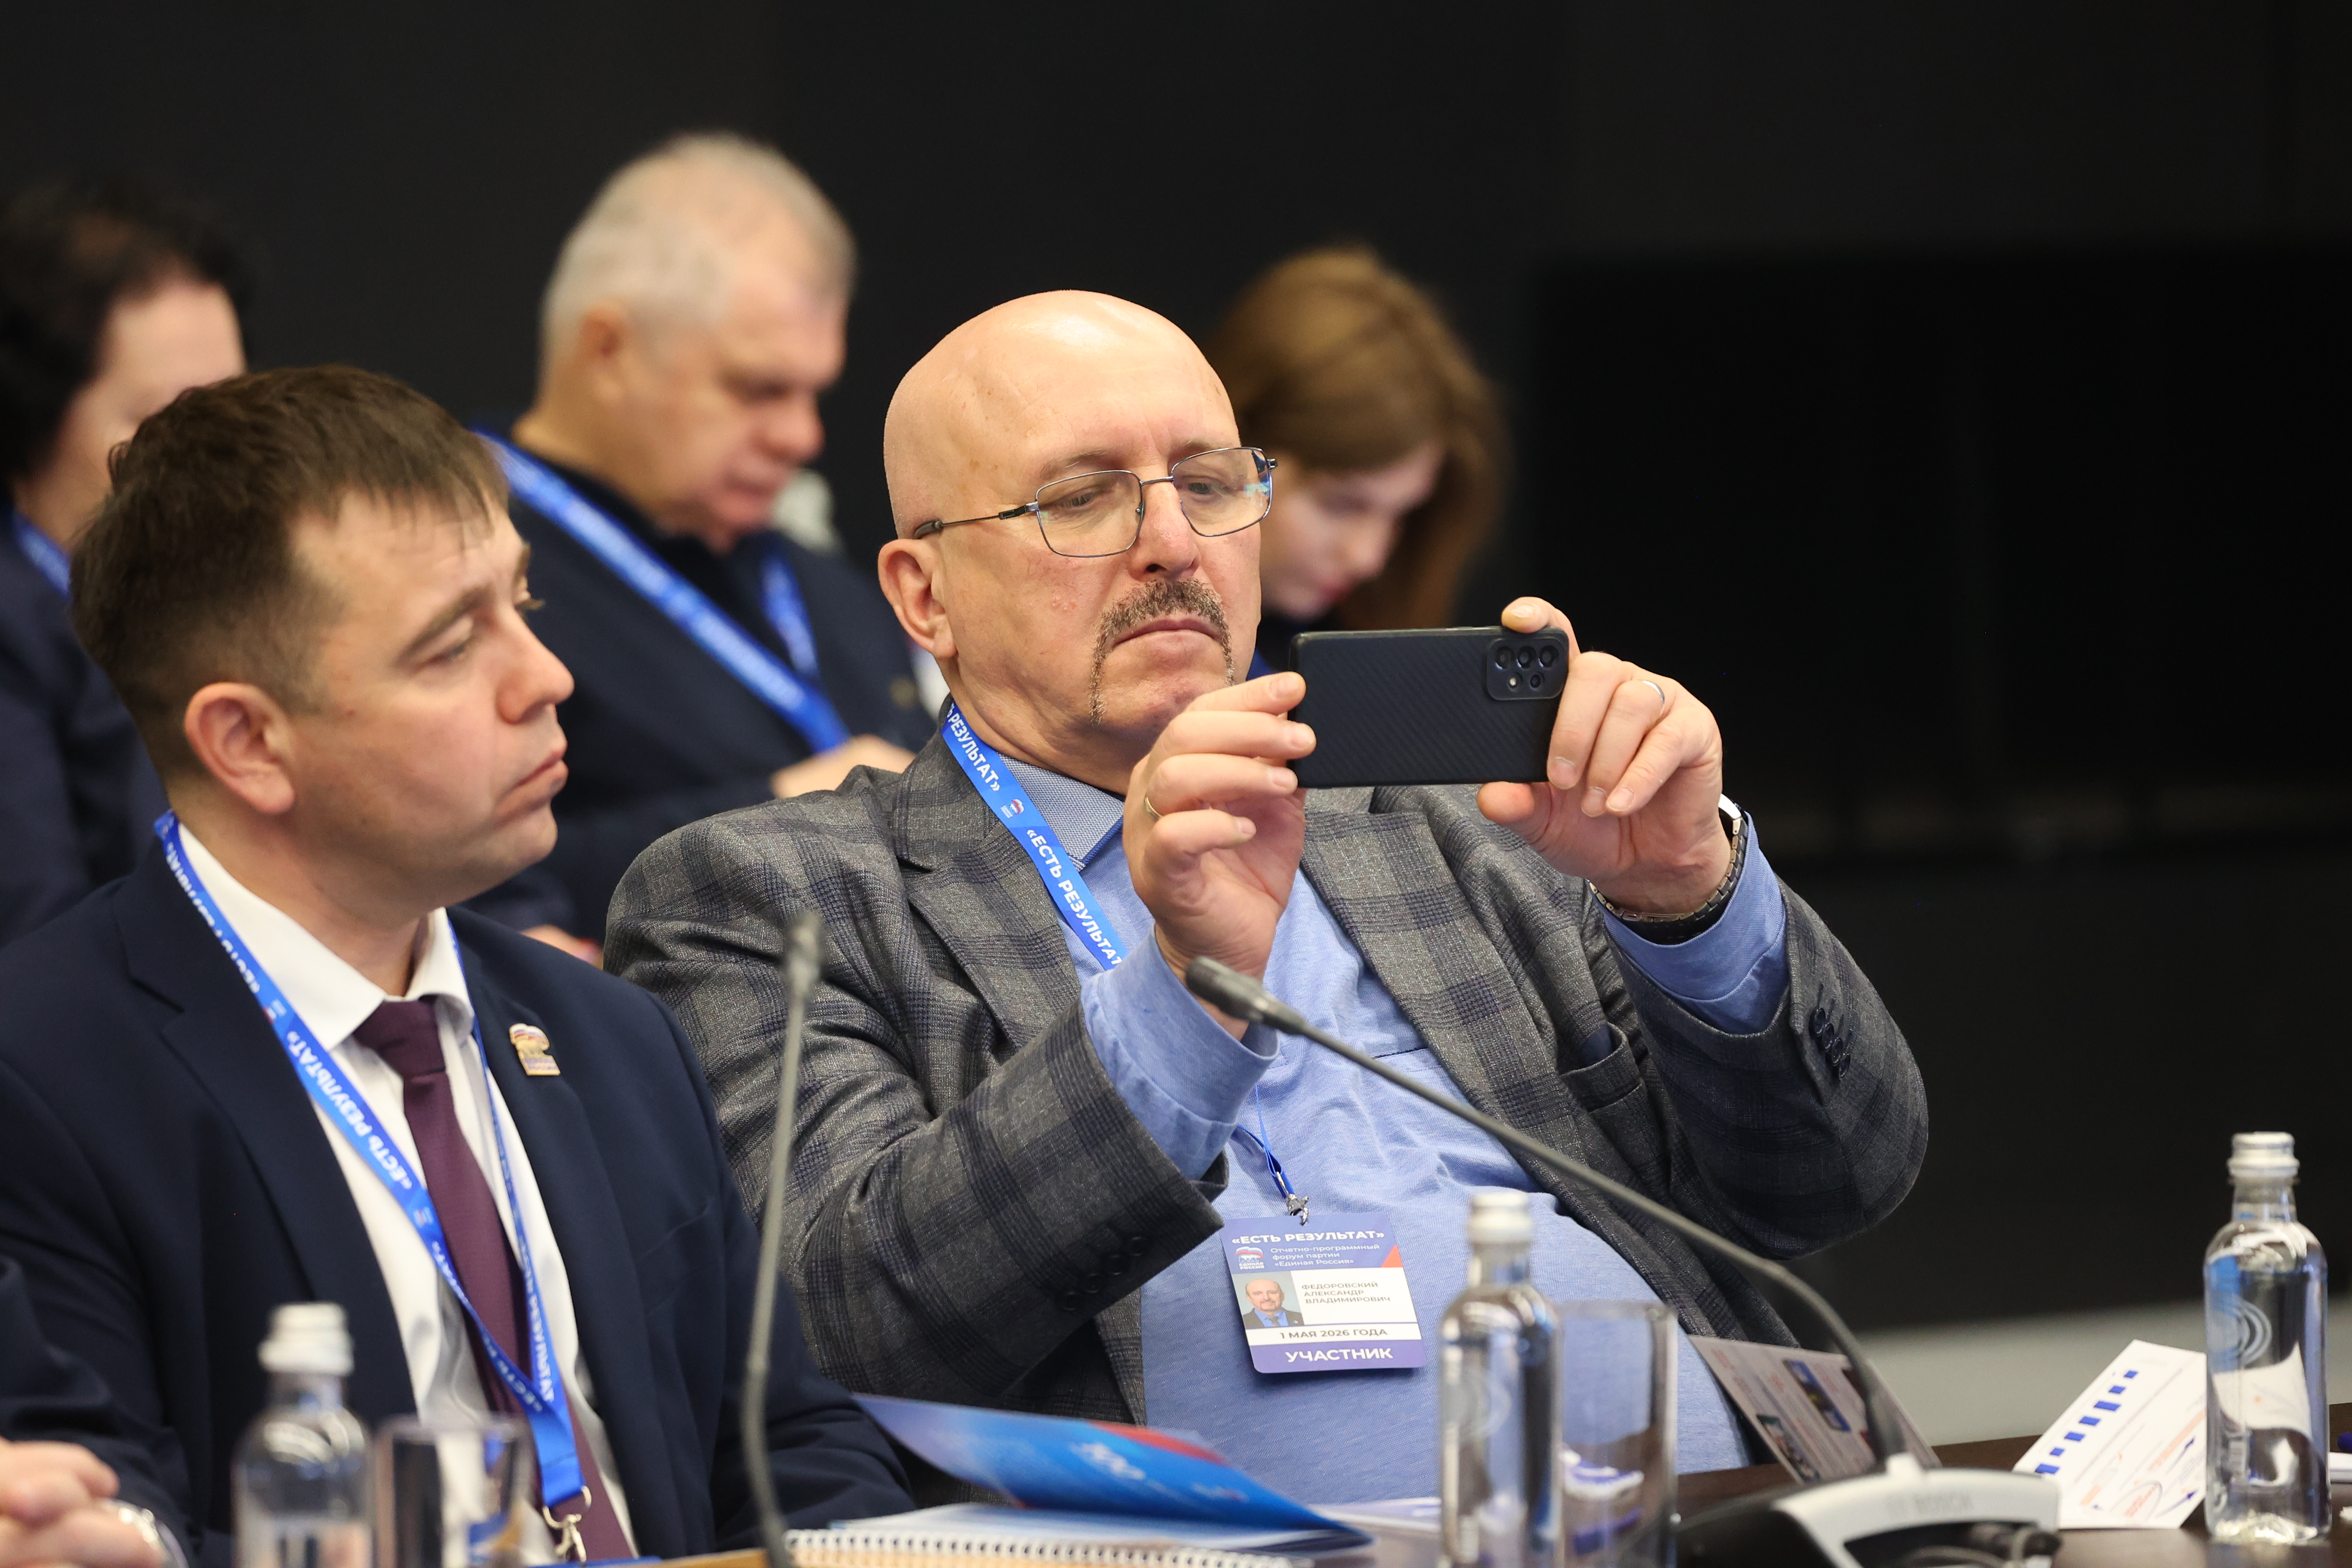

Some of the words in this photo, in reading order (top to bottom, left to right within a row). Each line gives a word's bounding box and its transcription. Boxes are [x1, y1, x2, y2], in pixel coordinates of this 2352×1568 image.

[948, 713, 1001, 791] РЕЗУЛЬТАТ»
[1026, 829, 1062, 878] «ЕСТЬ
[1232, 1235, 1281, 1244] «ЕСТЬ
[1284, 1231, 1385, 1242] РЕЗУЛЬТАТ»
[1270, 1244, 1380, 1253] Отчетно-программный
[1302, 1281, 1378, 1290] ФЕДОРОВСКИЙ
[1285, 1348, 1393, 1363] УЧАСТНИК
